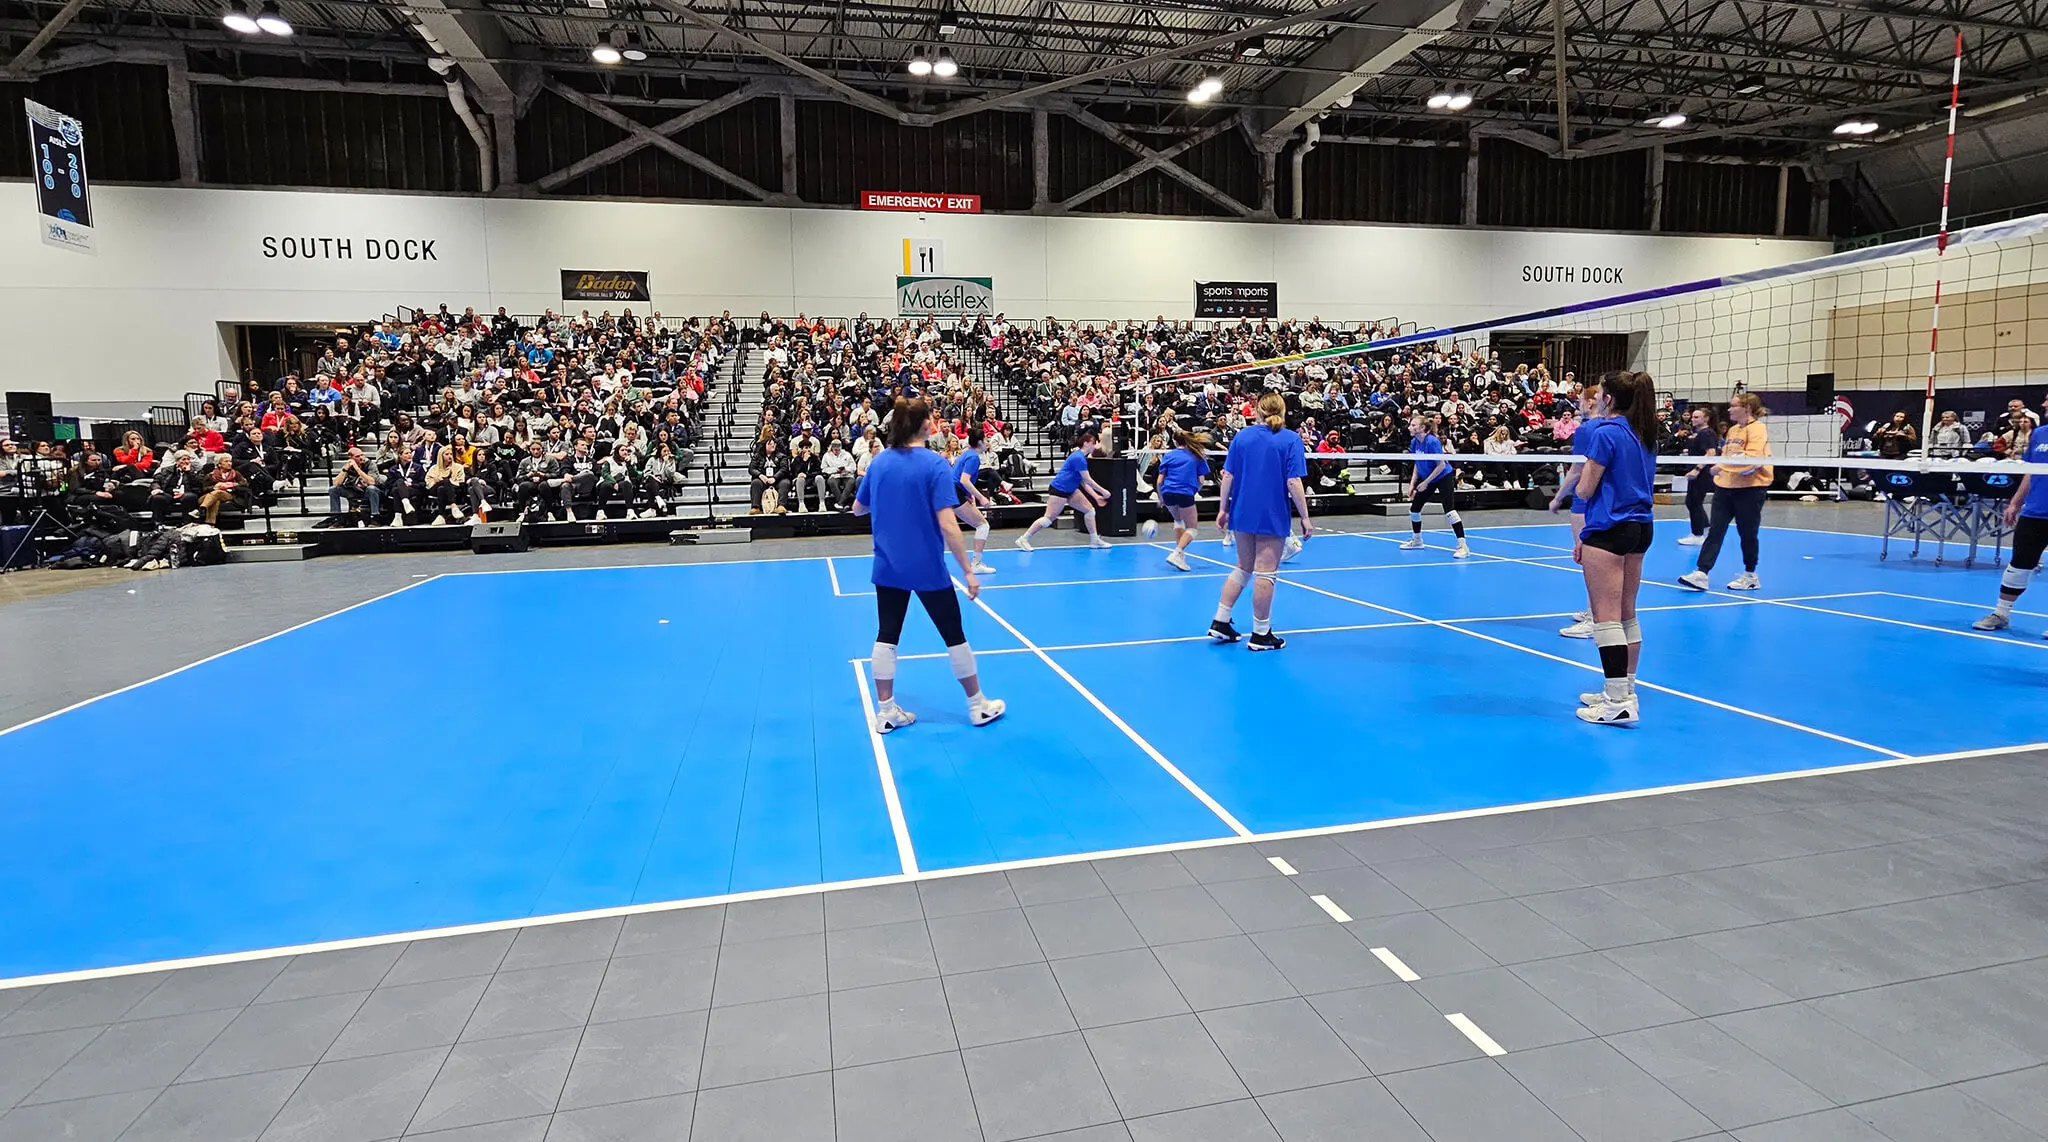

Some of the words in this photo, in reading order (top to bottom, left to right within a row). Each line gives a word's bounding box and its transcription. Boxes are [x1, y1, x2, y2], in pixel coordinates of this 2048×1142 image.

[49, 135, 67, 149] AISLE
[868, 194, 944, 209] EMERGENCY
[947, 197, 974, 210] EXIT
[262, 236, 352, 259] SOUTH
[366, 238, 438, 261] DOCK
[576, 274, 636, 290] Baden
[1522, 265, 1575, 283] SOUTH
[1581, 267, 1623, 284] DOCK
[614, 290, 631, 299] YOU
[902, 285, 988, 309] Matéflex
[1203, 286, 1233, 298] sports
